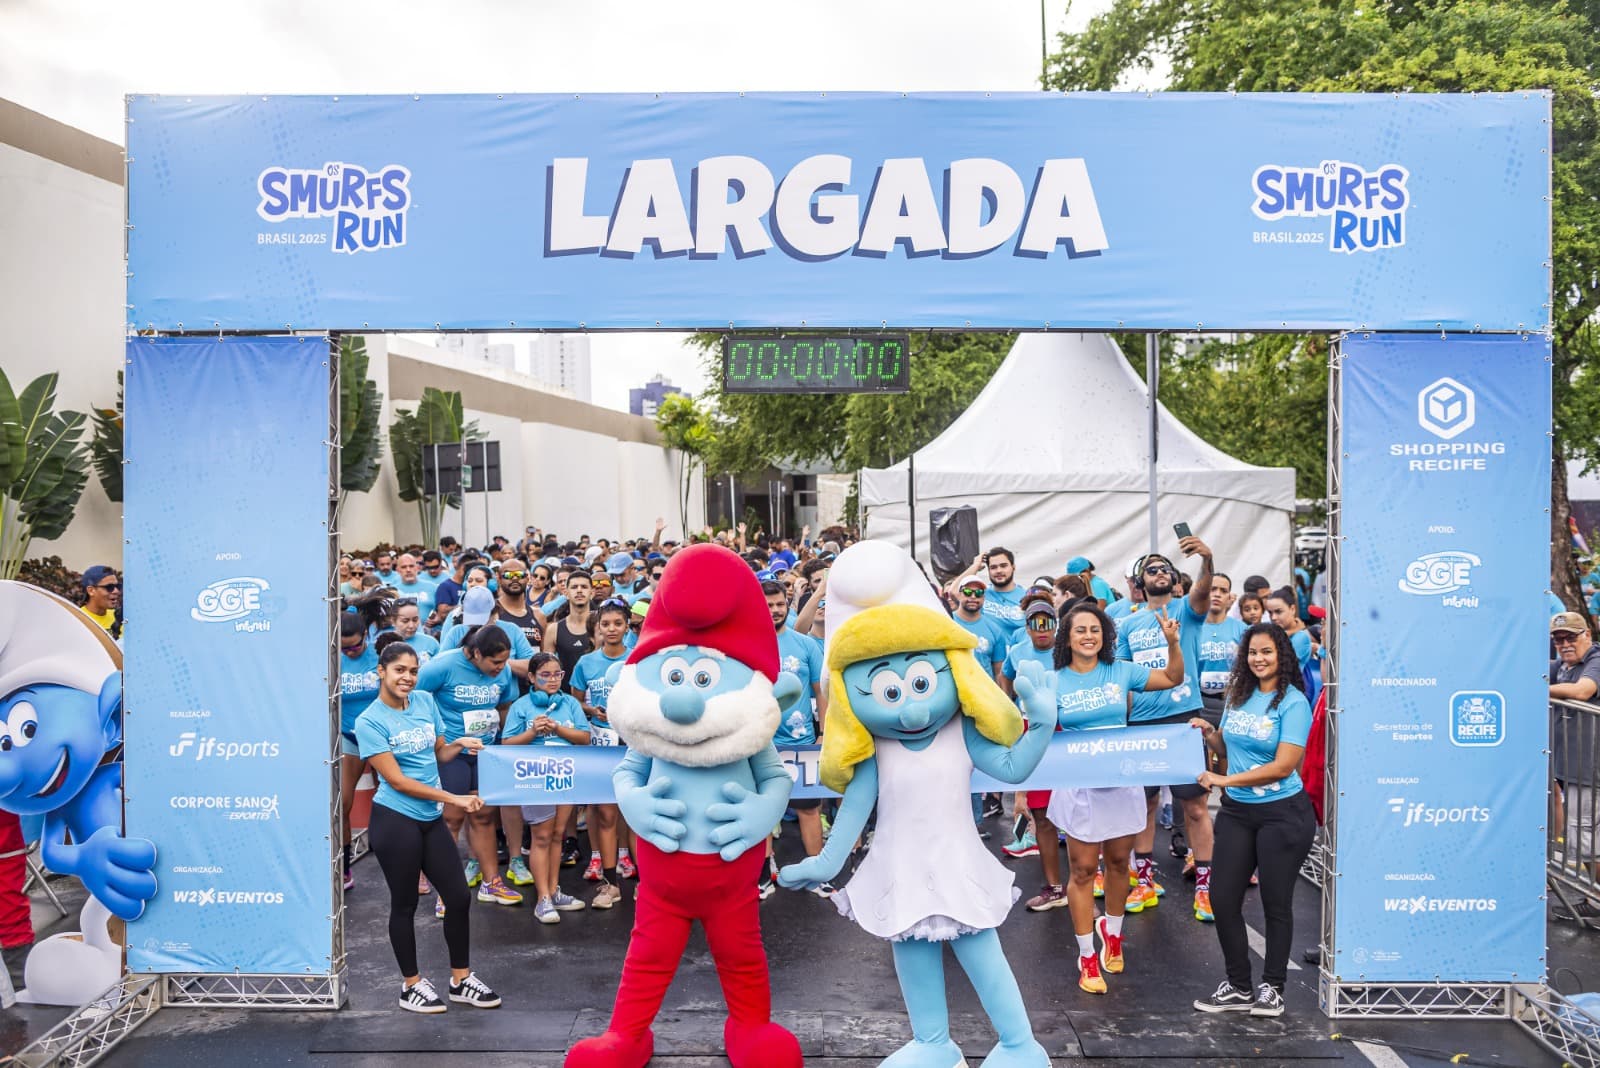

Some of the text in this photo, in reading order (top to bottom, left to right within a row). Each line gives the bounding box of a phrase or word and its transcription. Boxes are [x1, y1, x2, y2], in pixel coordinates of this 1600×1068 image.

[327, 164, 340, 176] OS
[260, 167, 408, 217] SMURFS
[1255, 165, 1406, 215] SMURFS
[544, 153, 1110, 261] LARGADA
[335, 210, 404, 252] RUN
[1333, 210, 1402, 251] RUN
[257, 233, 327, 245] BRASIL 2025
[1252, 232, 1325, 244] BRASIL 2025
[728, 342, 903, 381] 00:00:00
[1390, 442, 1506, 456] SHOPPING
[1409, 458, 1487, 471] RECIFE
[1406, 560, 1472, 586] GGE
[197, 587, 262, 613] GGE
[1442, 595, 1479, 608] infantil
[235, 619, 272, 633] infantil
[1137, 658, 1167, 669] 008
[1371, 677, 1438, 687] PATROCINADOR
[1062, 688, 1102, 707] SMURFS
[1084, 698, 1106, 711] RUN
[469, 720, 487, 731] 455
[1372, 723, 1433, 732] Secretaria de
[1458, 724, 1497, 736] RECIFE
[1392, 732, 1433, 742] Esportes
[196, 737, 280, 761] jfsports
[1106, 739, 1168, 752] EVENTOS
[515, 758, 574, 778] SMURFS
[545, 775, 573, 791] RUN
[170, 796, 272, 808] CORPORE SANO
[1404, 802, 1490, 827] jfsports
[217, 891, 284, 904] EVENTOS
[1428, 898, 1497, 912] EVENTOS
